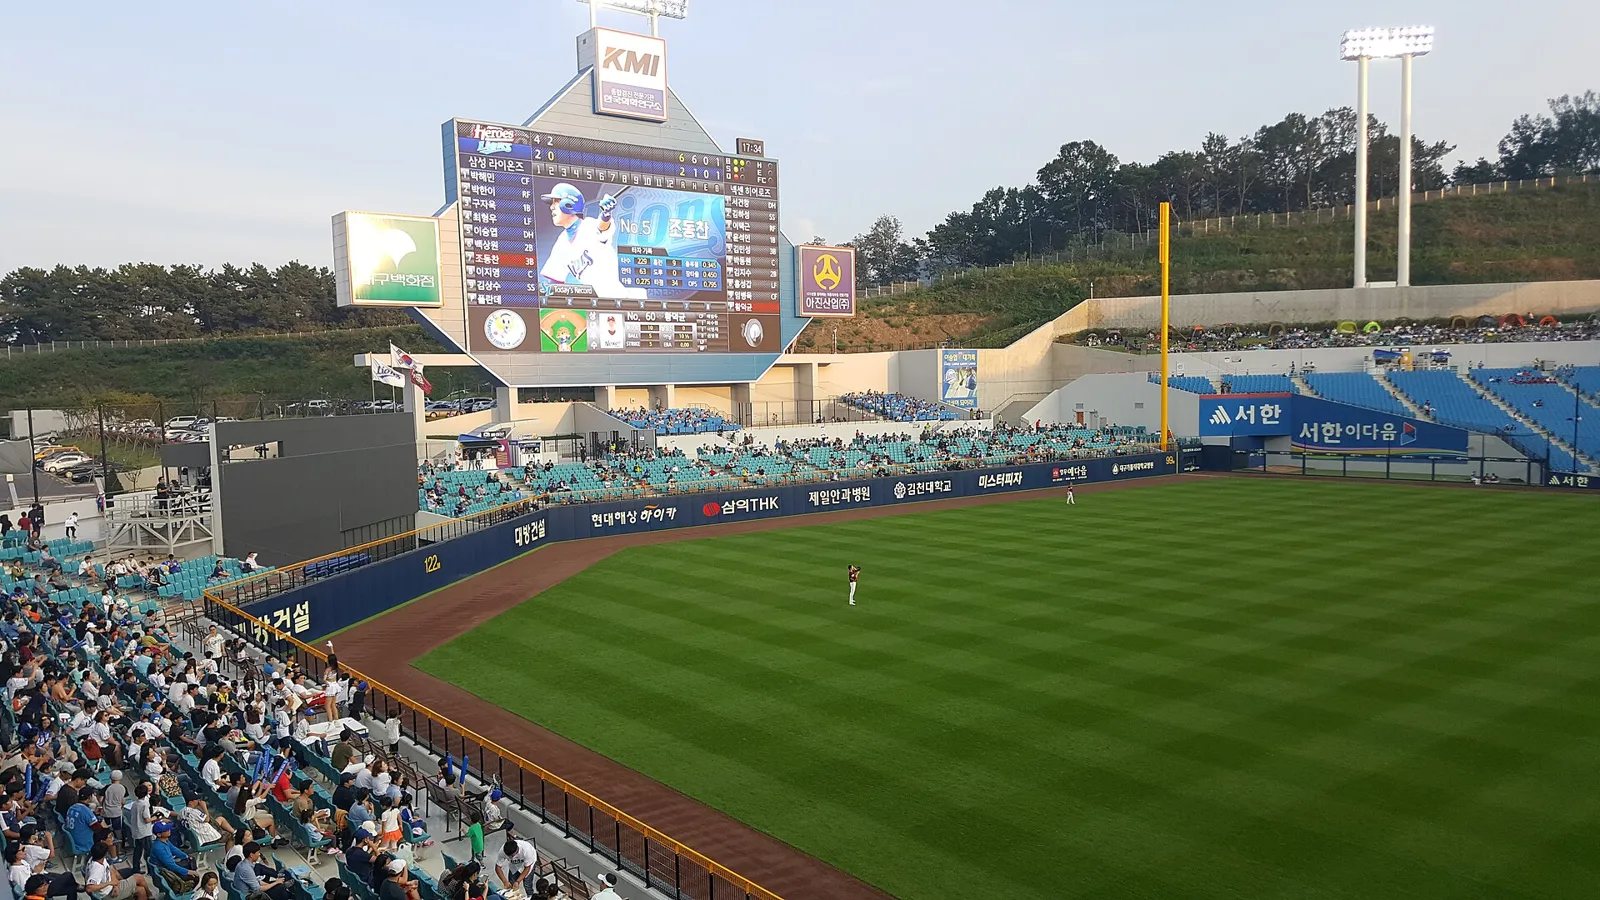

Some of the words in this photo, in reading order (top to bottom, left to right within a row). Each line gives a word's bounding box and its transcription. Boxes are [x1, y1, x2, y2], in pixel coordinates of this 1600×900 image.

[603, 46, 660, 76] KMI
[474, 125, 514, 141] Heroes
[534, 136, 540, 144] 4
[548, 136, 553, 146] 2
[680, 153, 684, 162] 6
[692, 154, 697, 164] 6
[704, 156, 708, 166] 0
[716, 157, 720, 166] 1
[742, 142, 762, 154] 17:34
[469, 156, 486, 169] 삼성
[488, 158, 524, 172] 라이온즈
[535, 150, 541, 159] 2
[548, 152, 554, 160] 0
[680, 167, 685, 176] 2
[694, 169, 698, 178] 1
[704, 170, 709, 178] 0
[716, 170, 720, 180] 1
[470, 170, 495, 182] 박해민
[537, 165, 540, 174] 1
[549, 166, 554, 176] 2
[562, 168, 566, 177] 3
[573, 170, 580, 178] 4
[586, 170, 592, 179] 5
[600, 172, 605, 181] 6
[610, 173, 616, 182] 7
[622, 175, 627, 184] 8
[633, 175, 639, 184] 9
[644, 176, 651, 186] 10
[656, 178, 662, 187] 11
[667, 178, 674, 188] 12
[471, 184, 496, 196] 박한이
[730, 184, 744, 196] 넥센
[745, 186, 771, 198] 히어로즈
[472, 199, 496, 210] 구자욱
[523, 204, 531, 212] 1B
[524, 218, 532, 226] LF
[620, 219, 650, 235] No.5
[669, 218, 709, 239] 조동찬
[474, 226, 498, 238] 이승엽
[524, 231, 534, 239] DH
[475, 240, 499, 251] 백상원
[475, 254, 500, 265] 조동찬
[476, 267, 500, 278] 이지영
[734, 269, 752, 277] 김지수
[477, 281, 501, 291] 김상수
[806, 296, 850, 310] 아진산업(주)
[627, 312, 640, 321] No.
[646, 312, 656, 321] 60
[1235, 404, 1282, 424] 서한
[978, 472, 1023, 488] 미스터피자
[1562, 476, 1589, 488] 서한
[907, 480, 952, 496] 김천대학교
[808, 486, 871, 506] 제일안과병원
[592, 510, 638, 528] 현대해상
[640, 506, 677, 523] 하이카
[514, 518, 546, 546] 대방건설
